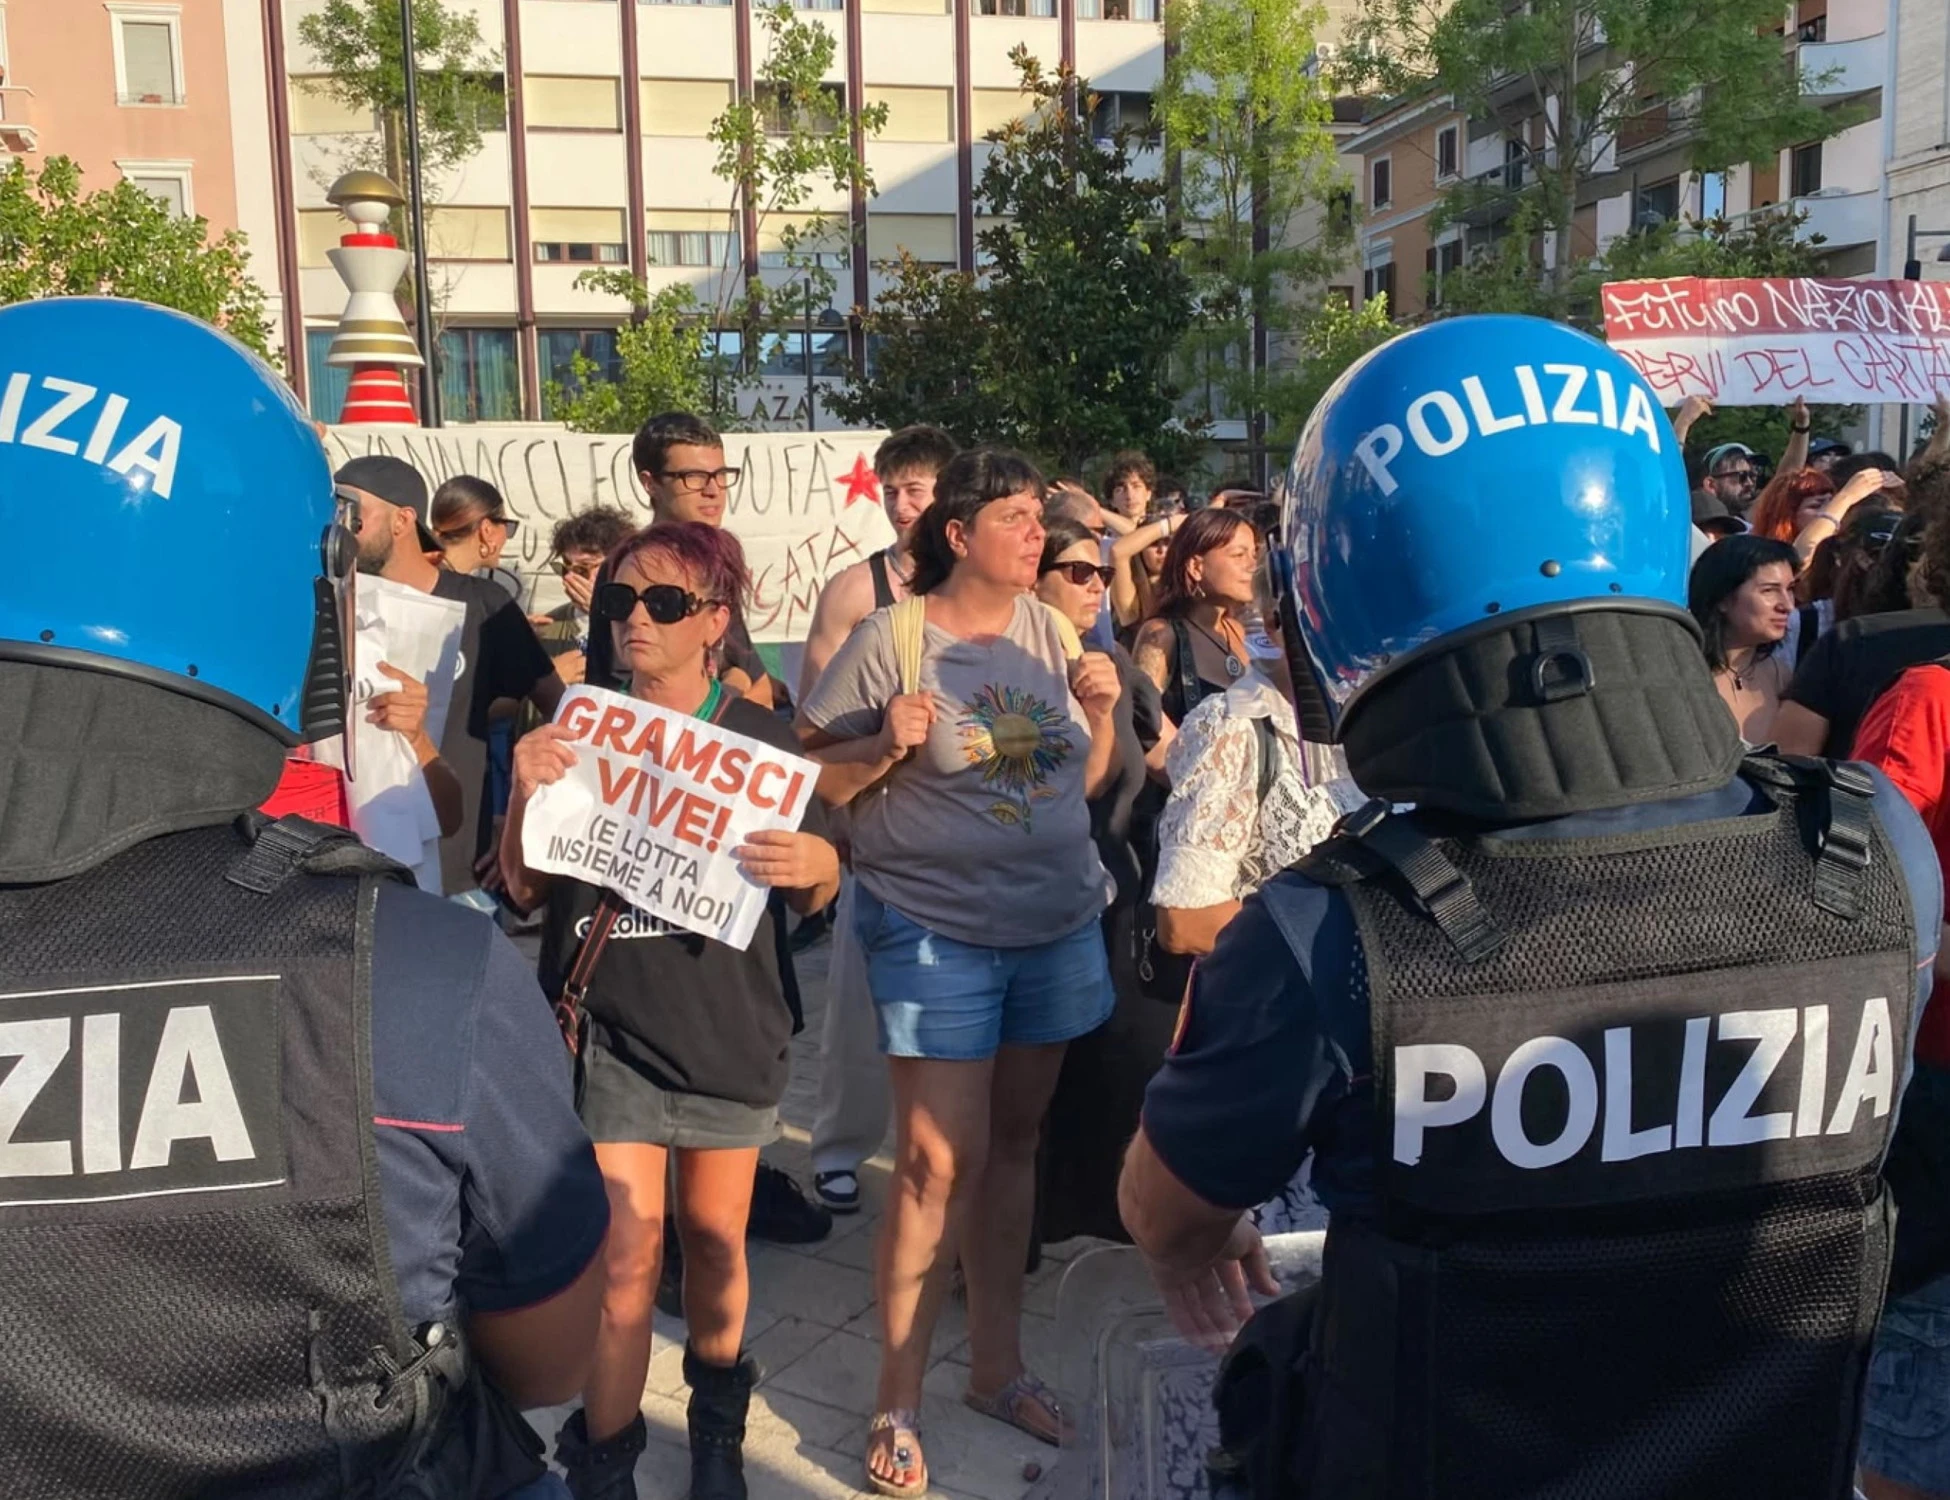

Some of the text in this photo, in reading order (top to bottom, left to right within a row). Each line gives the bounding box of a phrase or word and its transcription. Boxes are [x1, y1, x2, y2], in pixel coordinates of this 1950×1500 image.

[1762, 277, 1950, 338] NAZIONAL
[732, 395, 811, 421] LAZA
[1734, 346, 1834, 392] DEL
[1834, 332, 1950, 400] CAPITA
[1354, 363, 1661, 497] POLIZIA
[557, 696, 805, 817] GRAMSCI
[588, 814, 699, 886] (E LOTTA
[597, 757, 733, 854] VIVE!
[547, 835, 734, 930] INSIEME A NOI)
[1394, 997, 1893, 1169] POLIZIA
